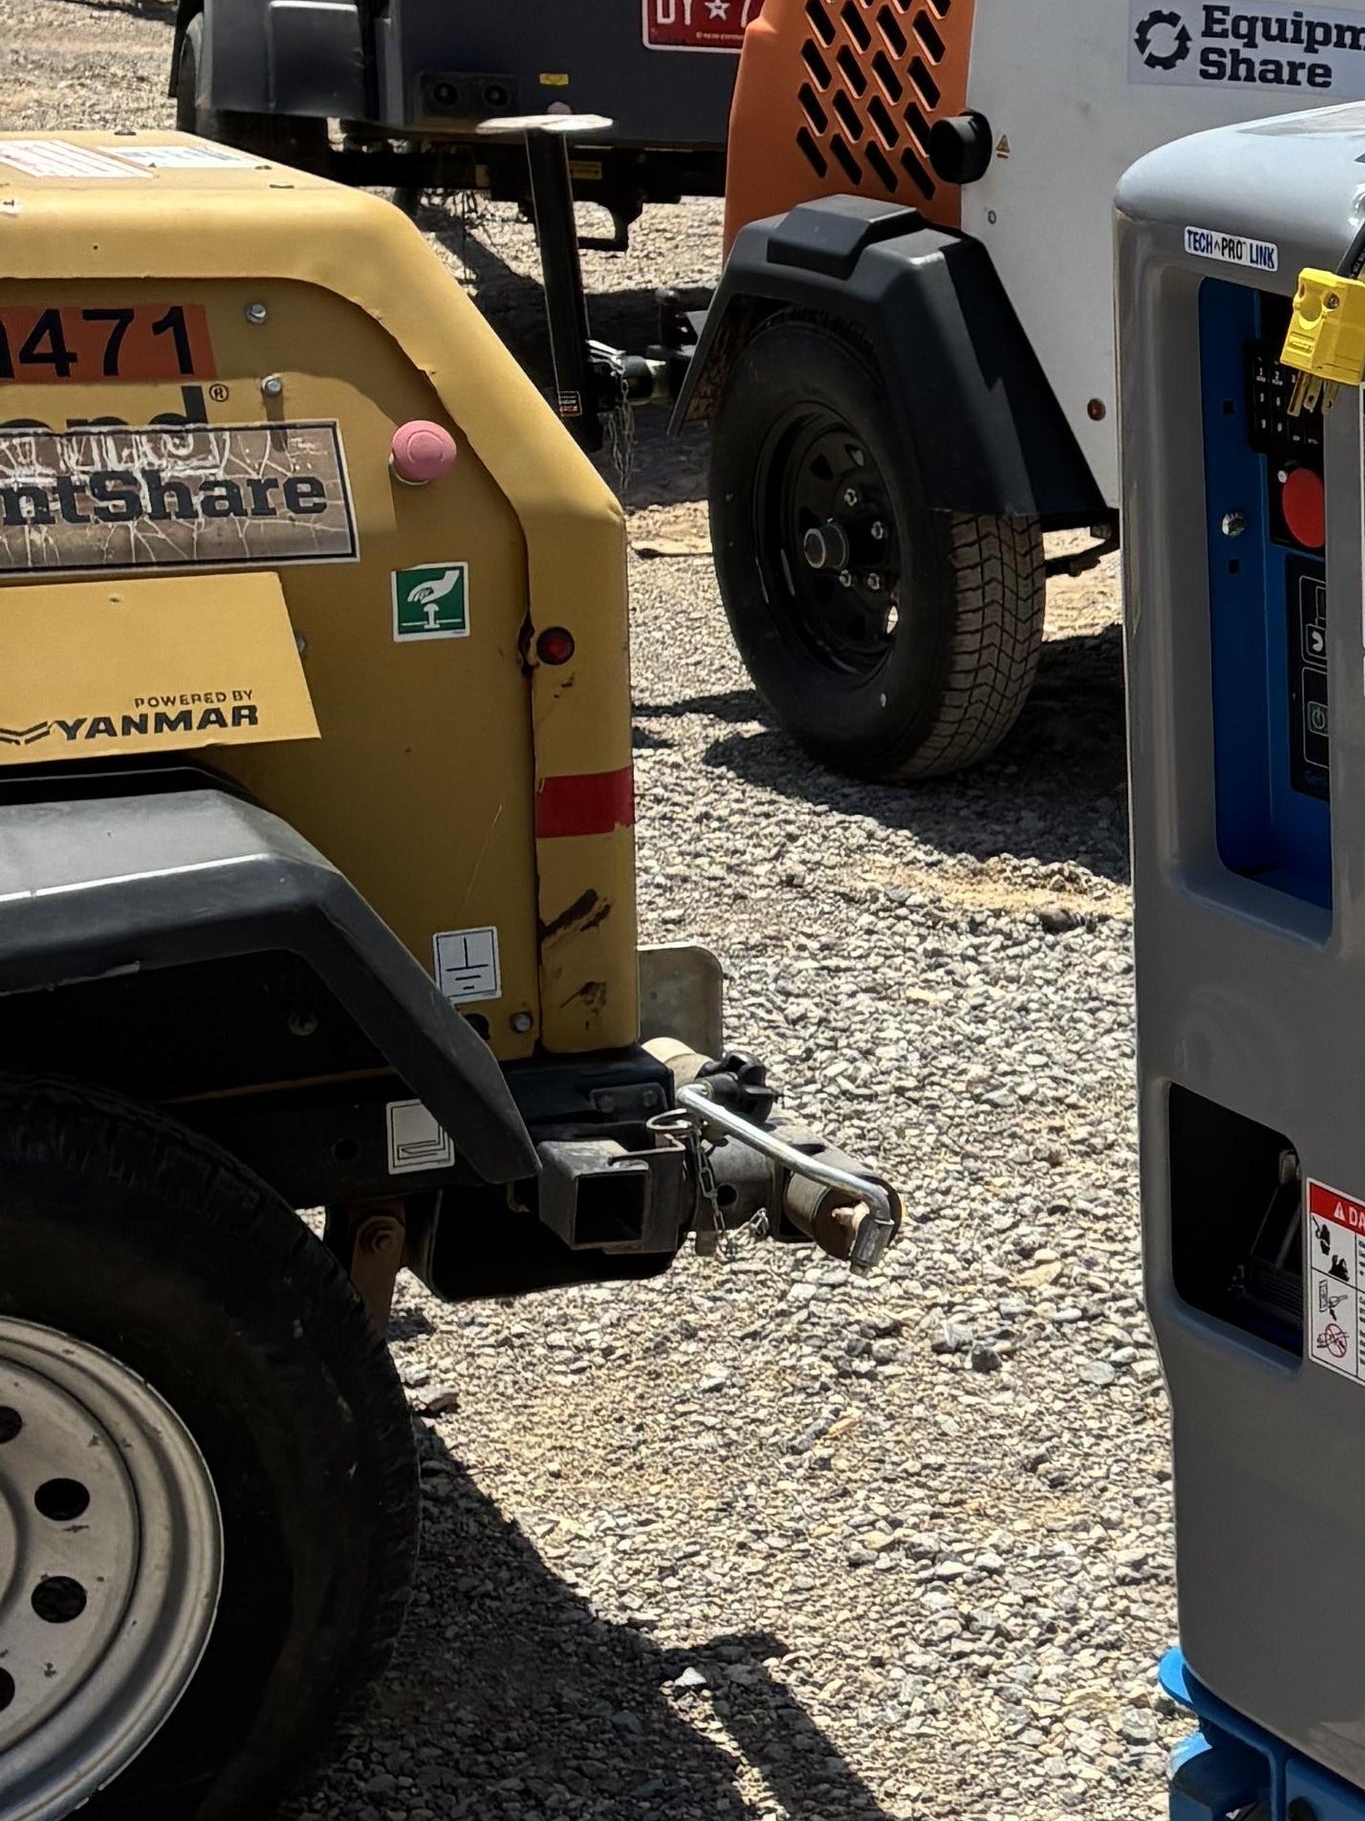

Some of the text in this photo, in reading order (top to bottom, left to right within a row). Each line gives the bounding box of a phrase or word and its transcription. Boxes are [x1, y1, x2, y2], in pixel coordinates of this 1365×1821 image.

[1200, 47, 1332, 89] Share
[1249, 242, 1275, 270] LINK
[134, 689, 254, 709] POWERED BY
[53, 704, 260, 742] YANMAR
